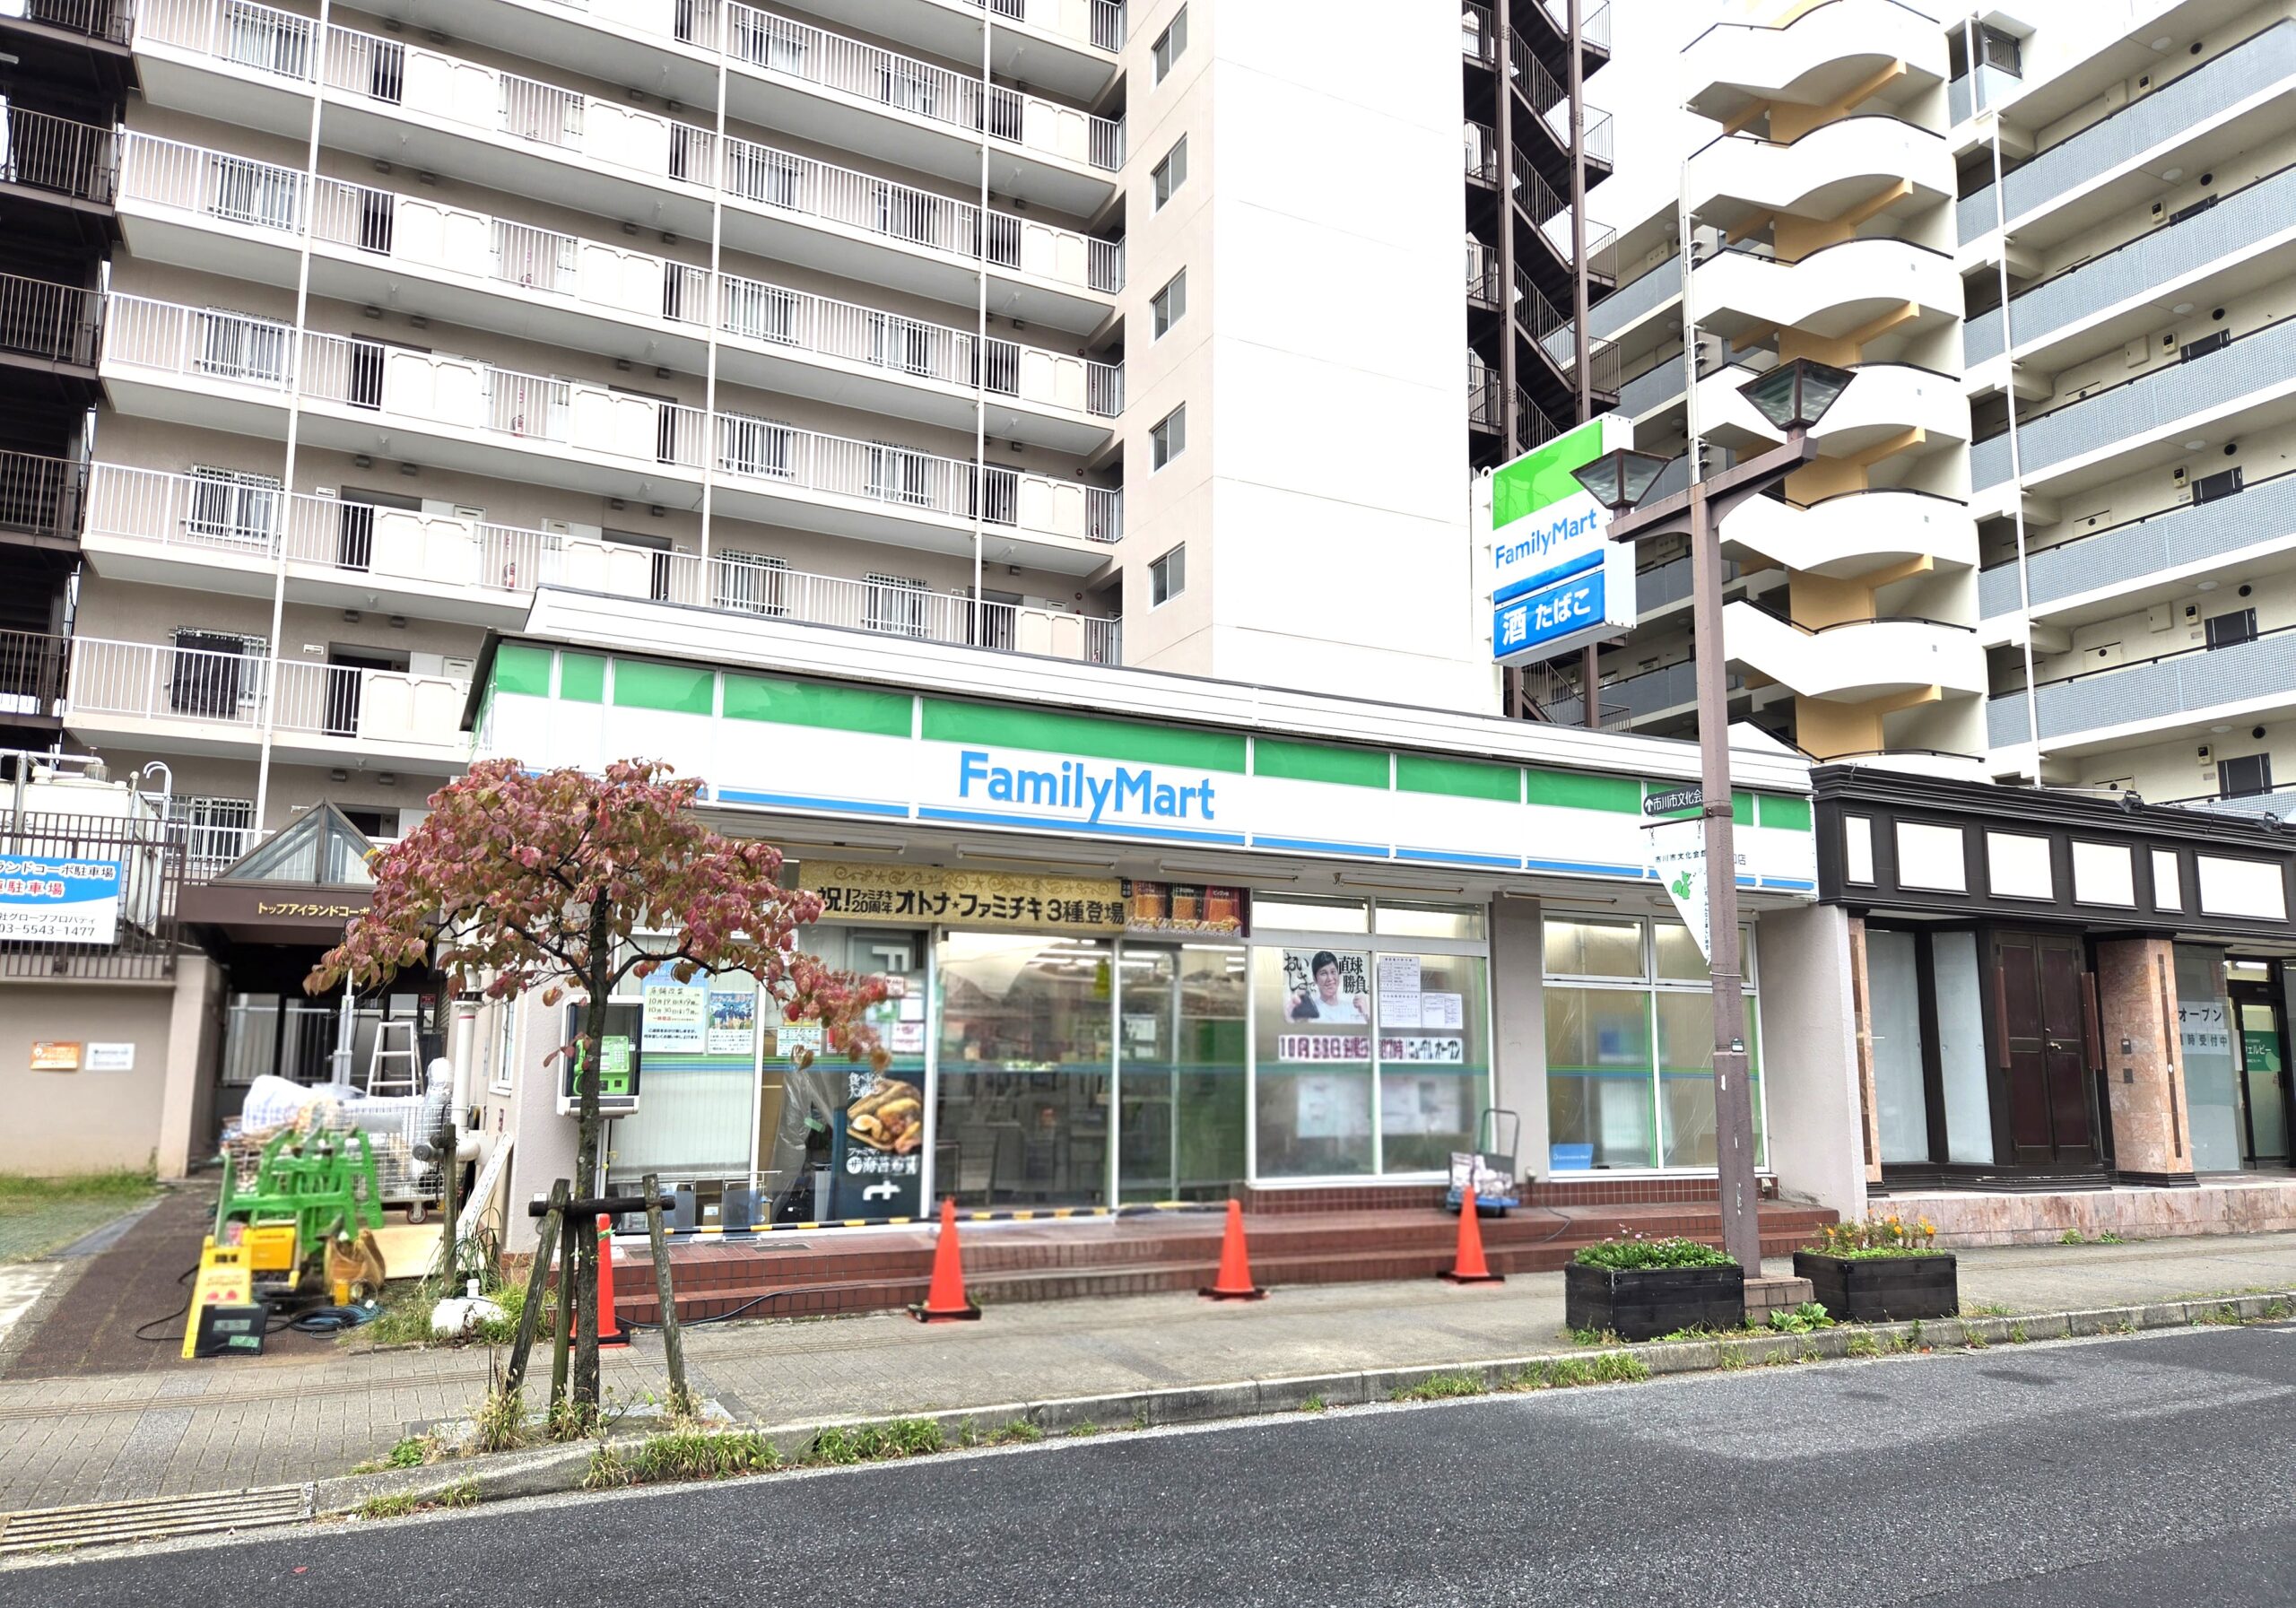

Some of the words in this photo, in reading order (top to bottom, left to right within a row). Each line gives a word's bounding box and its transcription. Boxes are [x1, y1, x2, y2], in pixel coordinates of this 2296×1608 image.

[1495, 508, 1597, 569] FamilyMart
[1502, 606, 1526, 646] 酒
[1535, 587, 1591, 630] たばこ
[959, 751, 1214, 823] FamilyMart
[0, 880, 64, 895] 駐車場
[853, 889, 893, 900] ファミチキ
[853, 900, 892, 913] 20周年
